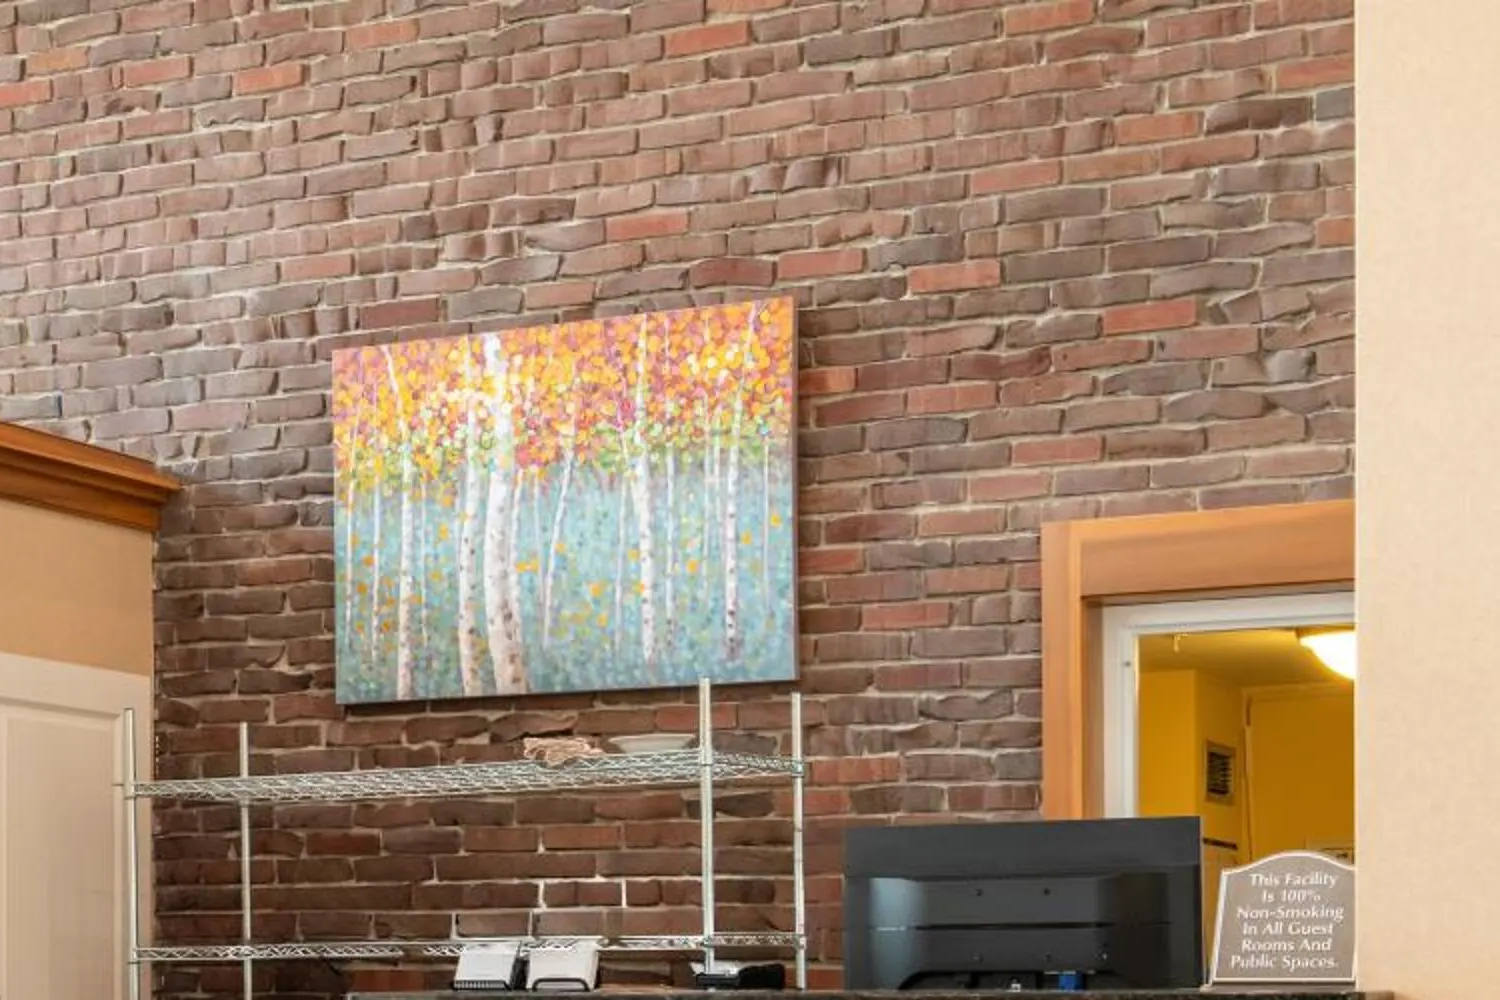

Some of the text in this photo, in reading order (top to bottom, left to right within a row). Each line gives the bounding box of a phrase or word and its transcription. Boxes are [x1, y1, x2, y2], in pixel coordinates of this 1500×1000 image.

[1250, 871, 1338, 888] This Facility
[1262, 888, 1321, 902] Is 100%
[1237, 905, 1345, 921] Non-Smoking
[1242, 922, 1334, 935] In All Guest
[1240, 937, 1333, 952] Rooms And
[1230, 954, 1339, 972] Public Spaces.
